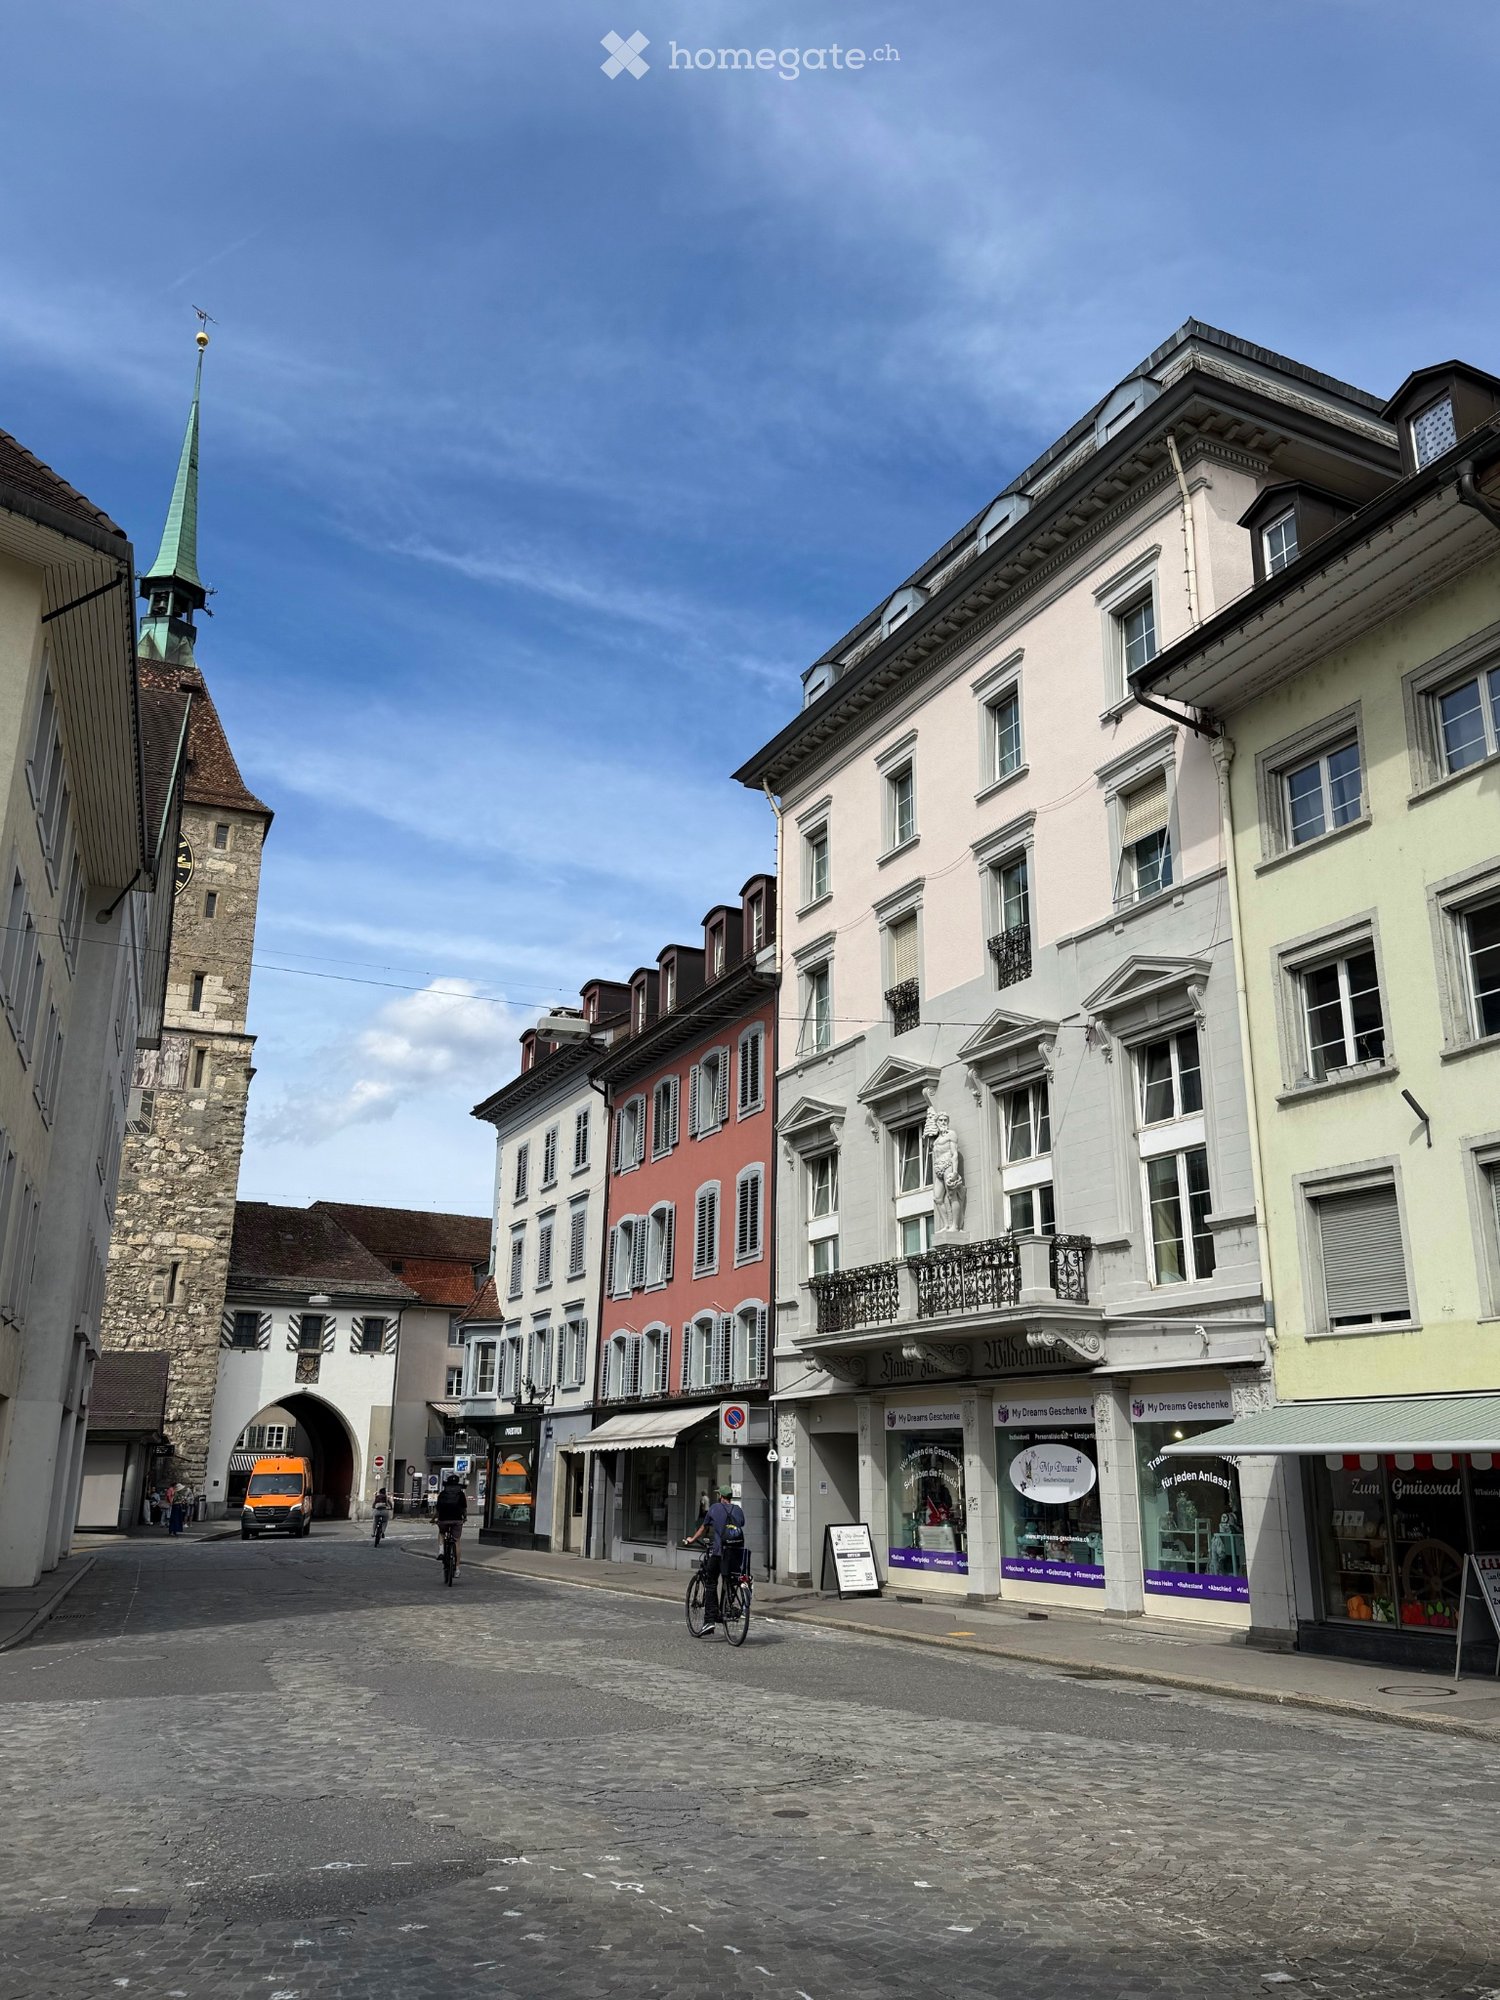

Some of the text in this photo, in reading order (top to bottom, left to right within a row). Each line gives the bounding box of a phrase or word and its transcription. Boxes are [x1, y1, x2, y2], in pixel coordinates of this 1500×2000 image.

[1012, 1406, 1087, 1418] My Dreams Geschenke
[1147, 1400, 1229, 1413] My Dreams Geschenke
[899, 1412, 961, 1423] My Dreams Geschenke
[925, 1446, 933, 1455] die
[1040, 1461, 1078, 1476] My Dreams
[1161, 1470, 1232, 1490] für jeden Anlass!
[1352, 1478, 1462, 1500] Zum Gmüesrad
